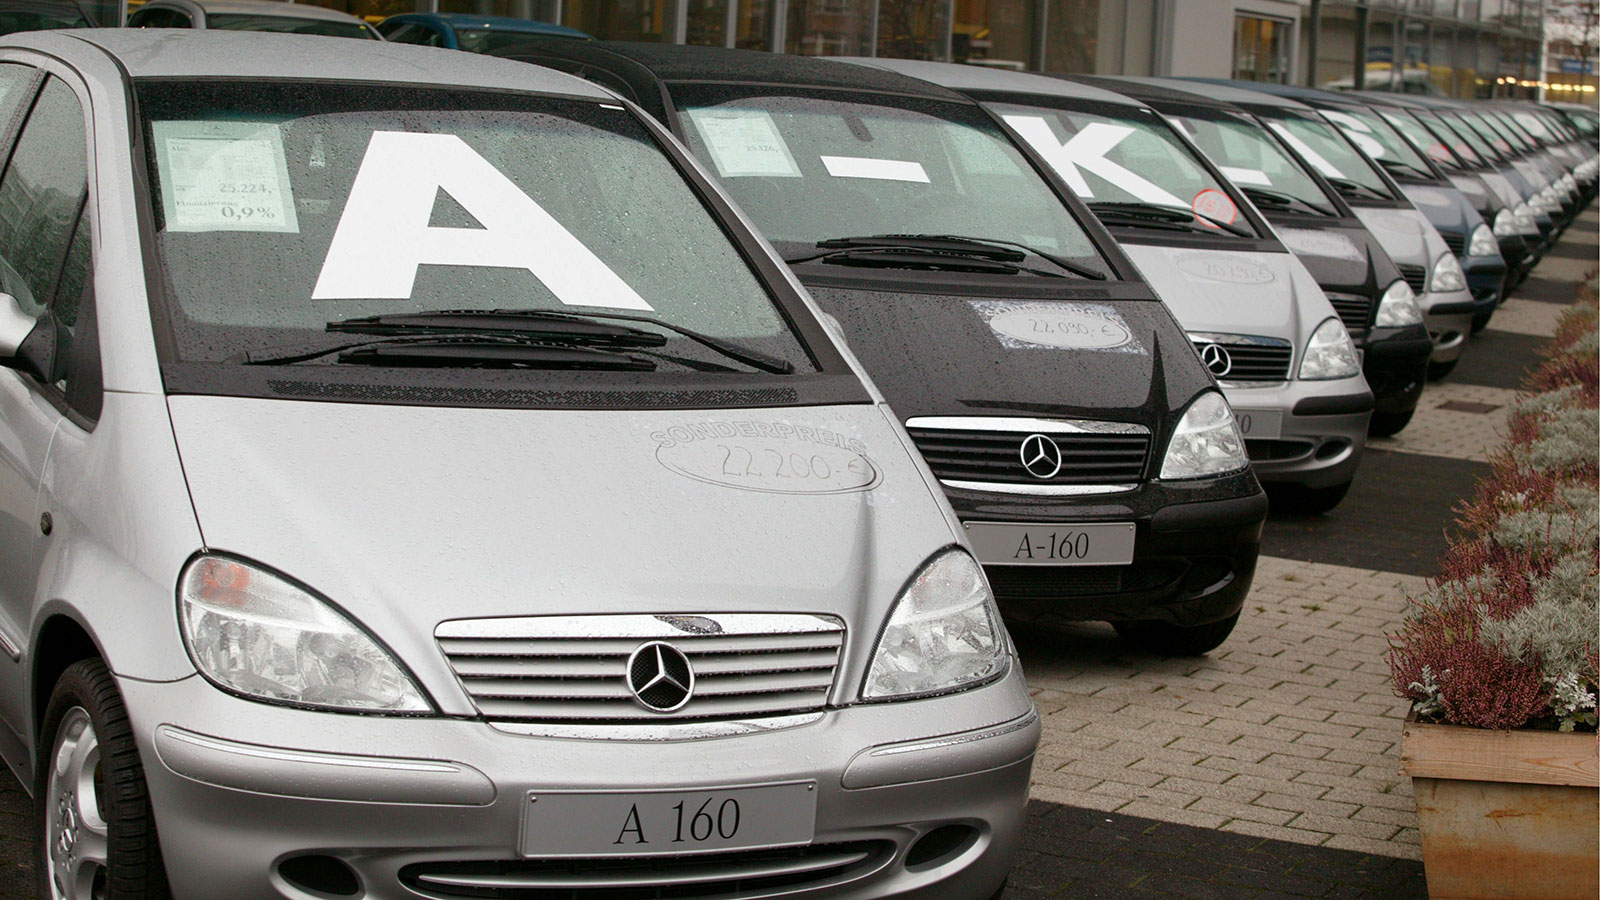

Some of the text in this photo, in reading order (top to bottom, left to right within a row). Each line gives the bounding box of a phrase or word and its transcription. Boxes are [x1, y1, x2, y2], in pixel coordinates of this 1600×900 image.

[1001, 114, 1193, 209] K
[311, 130, 655, 311] A
[649, 420, 868, 458] SONDERPREIS
[1012, 530, 1090, 560] A-160
[612, 796, 741, 845] A 160
